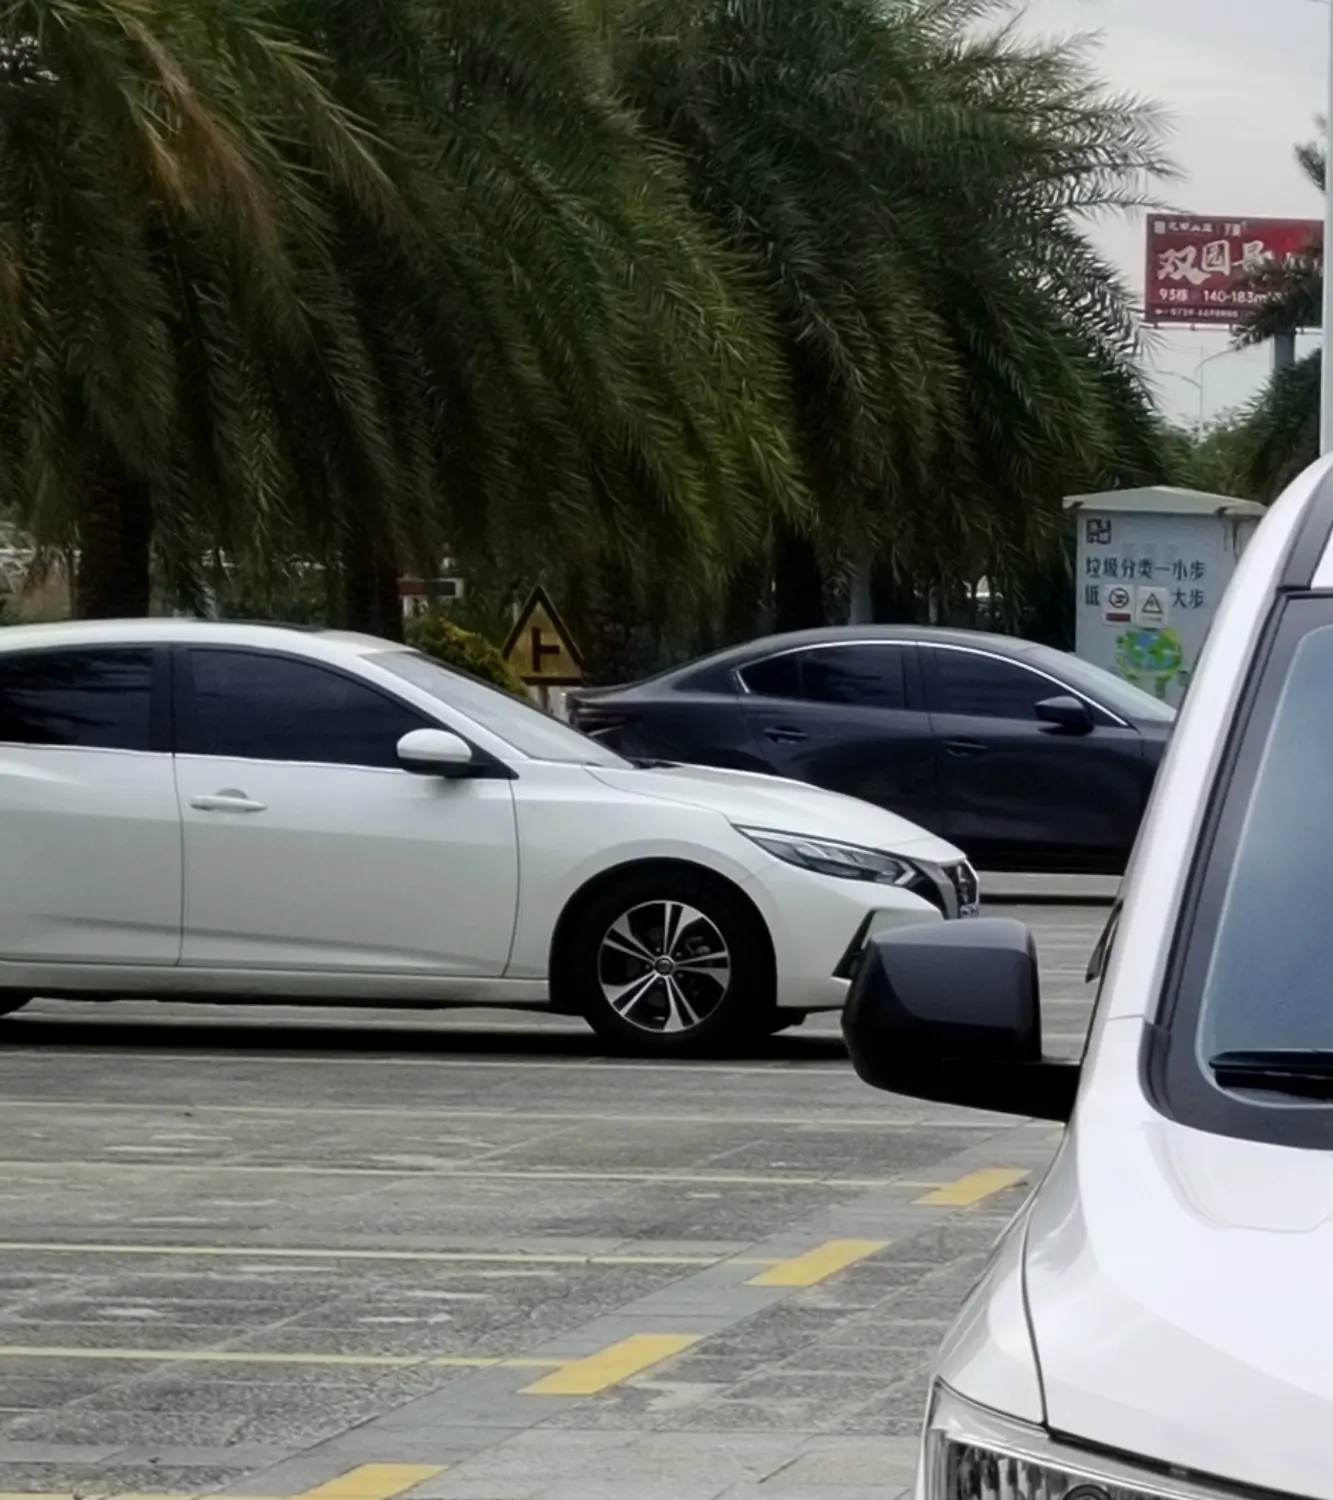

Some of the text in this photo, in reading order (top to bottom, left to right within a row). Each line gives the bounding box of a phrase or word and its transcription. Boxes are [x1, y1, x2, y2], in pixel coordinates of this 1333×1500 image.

[1085, 556, 1206, 581] 垃圾分类一小步
